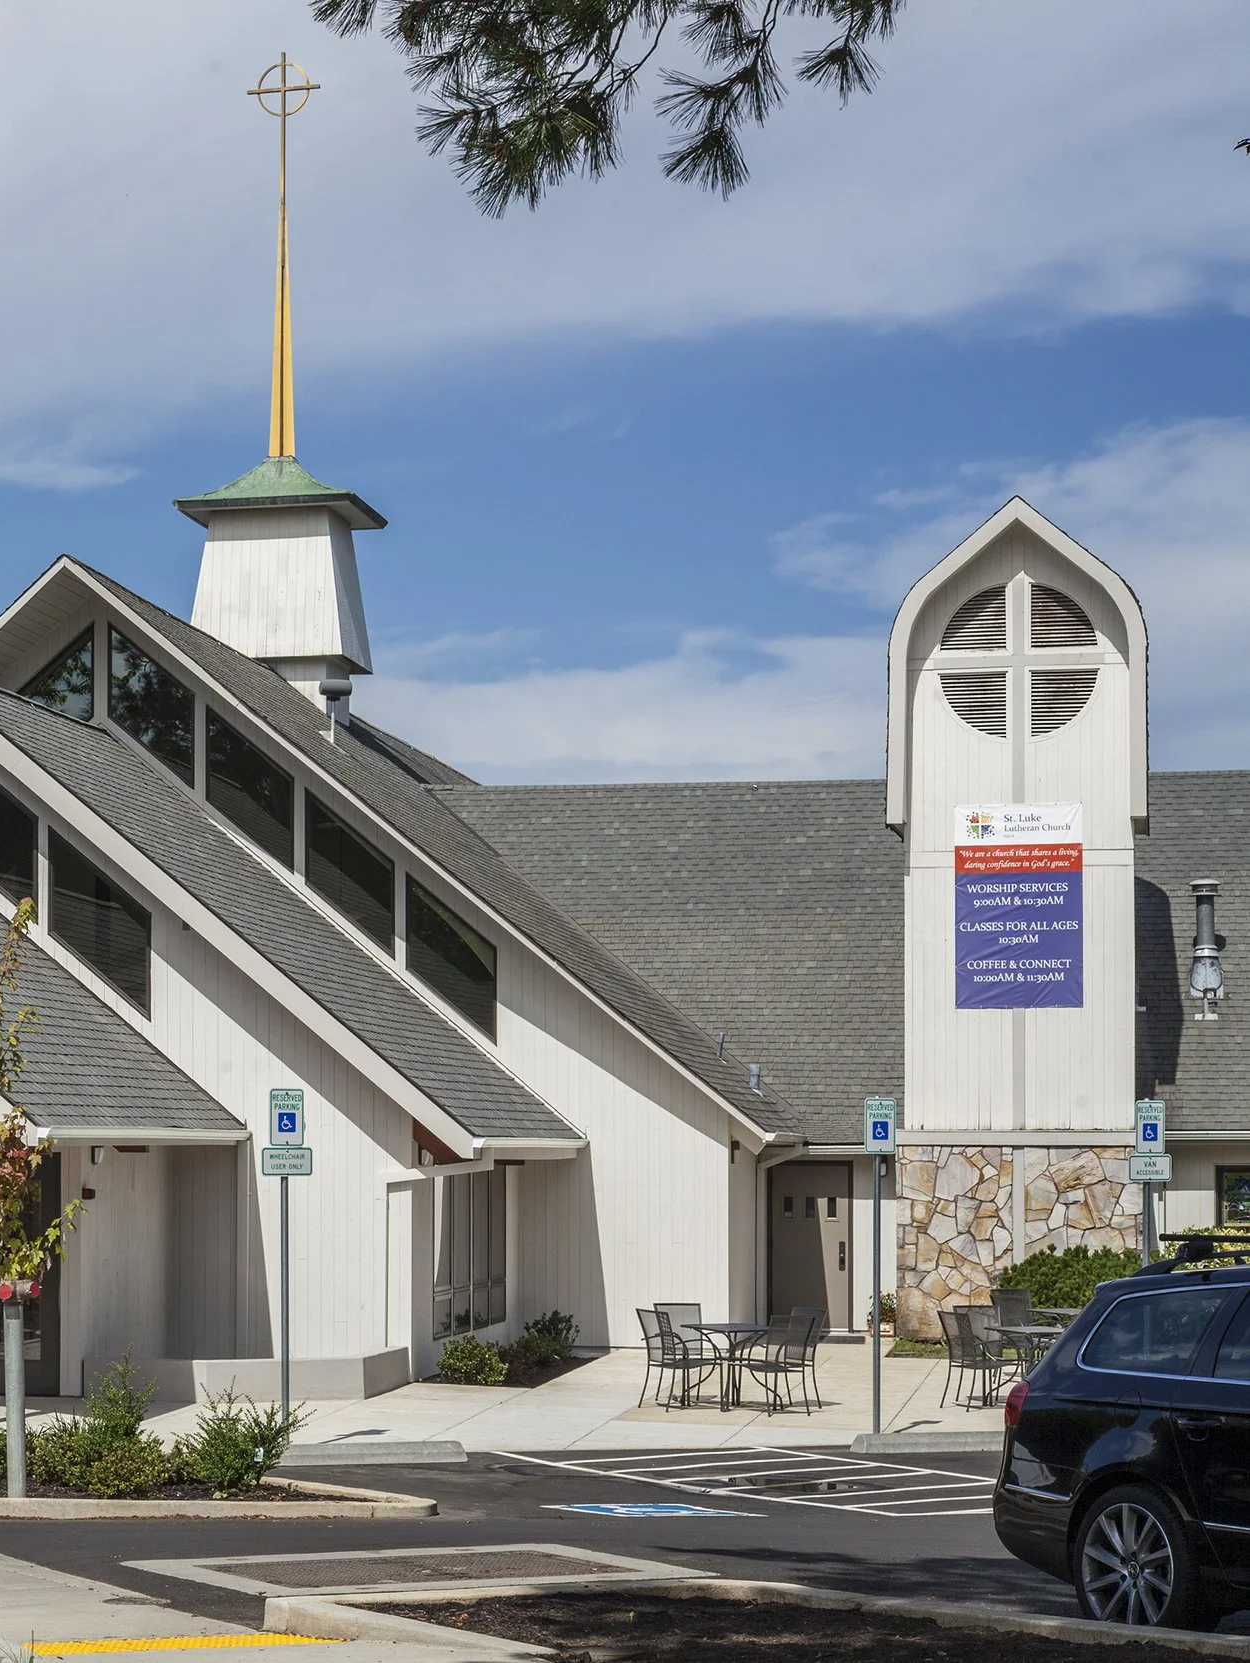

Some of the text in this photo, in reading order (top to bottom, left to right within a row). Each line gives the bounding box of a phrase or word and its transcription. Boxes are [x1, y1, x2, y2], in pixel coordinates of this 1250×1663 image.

[1004, 813, 1042, 822] St. Luke
[1004, 823, 1071, 832] Lutheran Church
[992, 849, 1014, 857] church
[1015, 849, 1029, 857] that
[1031, 848, 1052, 857] shares
[1058, 848, 1079, 858] living,
[964, 861, 986, 870] daring
[987, 860, 1021, 870] confidence
[1023, 860, 1030, 868] in
[1031, 859, 1050, 869] God's
[967, 882, 1068, 893] WORSHIP SERVICES
[973, 895, 1064, 908] 9:00AM & 10:30AM
[959, 920, 1079, 932] CLASSES FOR ALL AGES
[999, 934, 1039, 945] 10:30AM
[967, 959, 1072, 970] COFFEE & CONNECT
[973, 972, 1065, 983] 10:00AM & 11:30AM
[272, 1094, 302, 1102] RESERVED
[274, 1103, 300, 1111] PARKING
[867, 1103, 894, 1111] RESERVED
[869, 1112, 892, 1120] PARKING
[1139, 1114, 1161, 1122] PARKING
[1143, 1160, 1157, 1168] VAN
